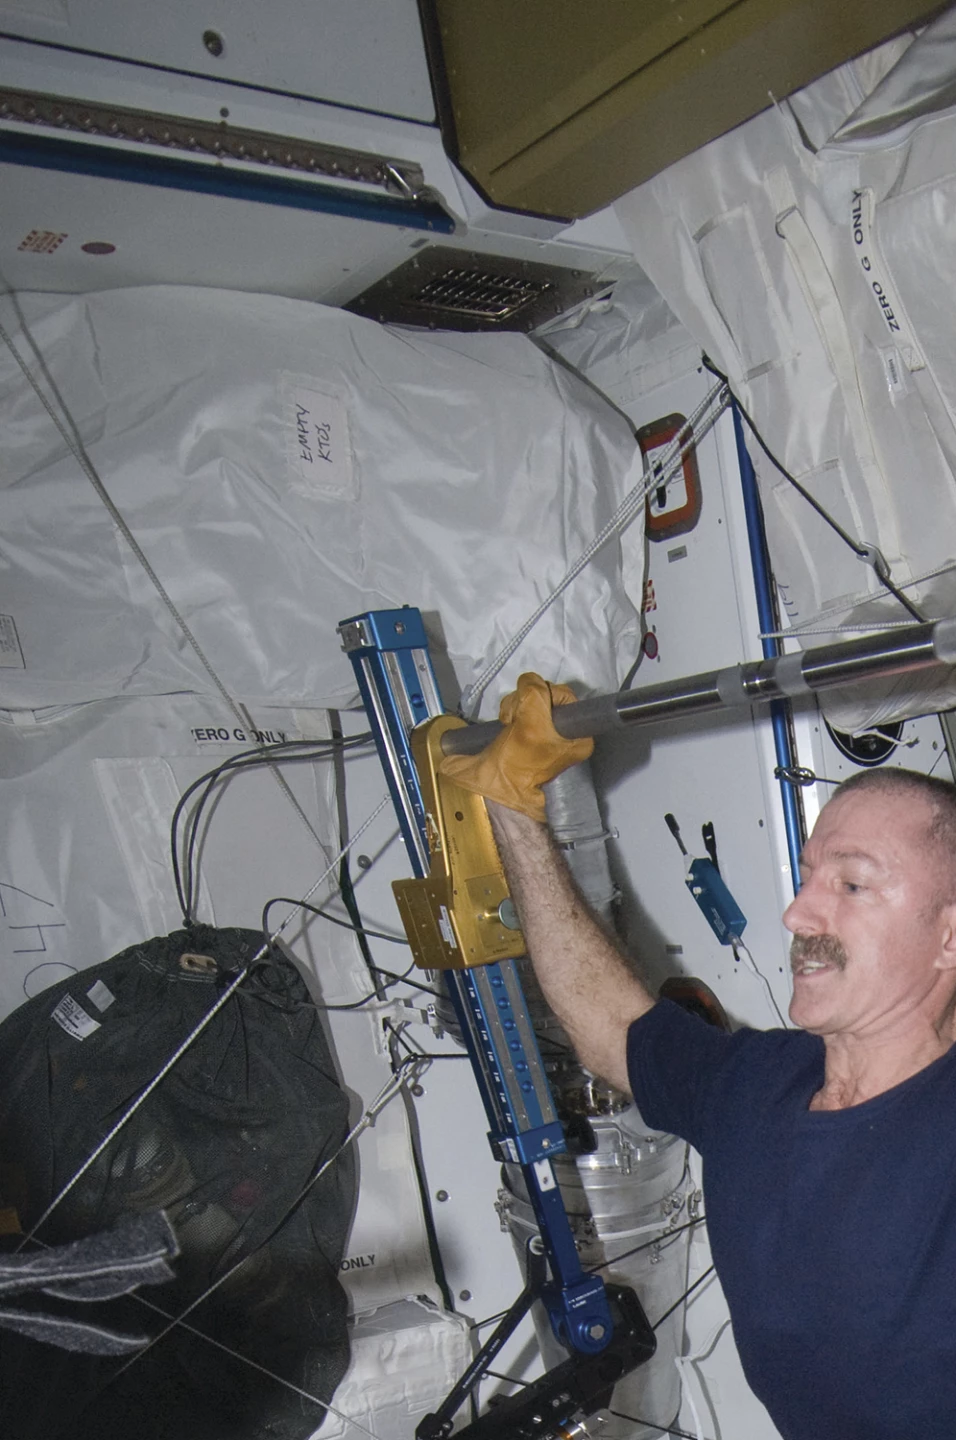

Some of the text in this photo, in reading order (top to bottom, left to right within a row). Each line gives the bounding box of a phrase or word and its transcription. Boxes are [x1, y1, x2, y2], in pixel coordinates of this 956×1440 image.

[852, 190, 901, 333] ZERO G ONLY
[296, 403, 313, 463] EMPTY
[191, 728, 230, 742] ERO
[233, 728, 246, 742] G
[341, 1254, 376, 1271] ONLY
